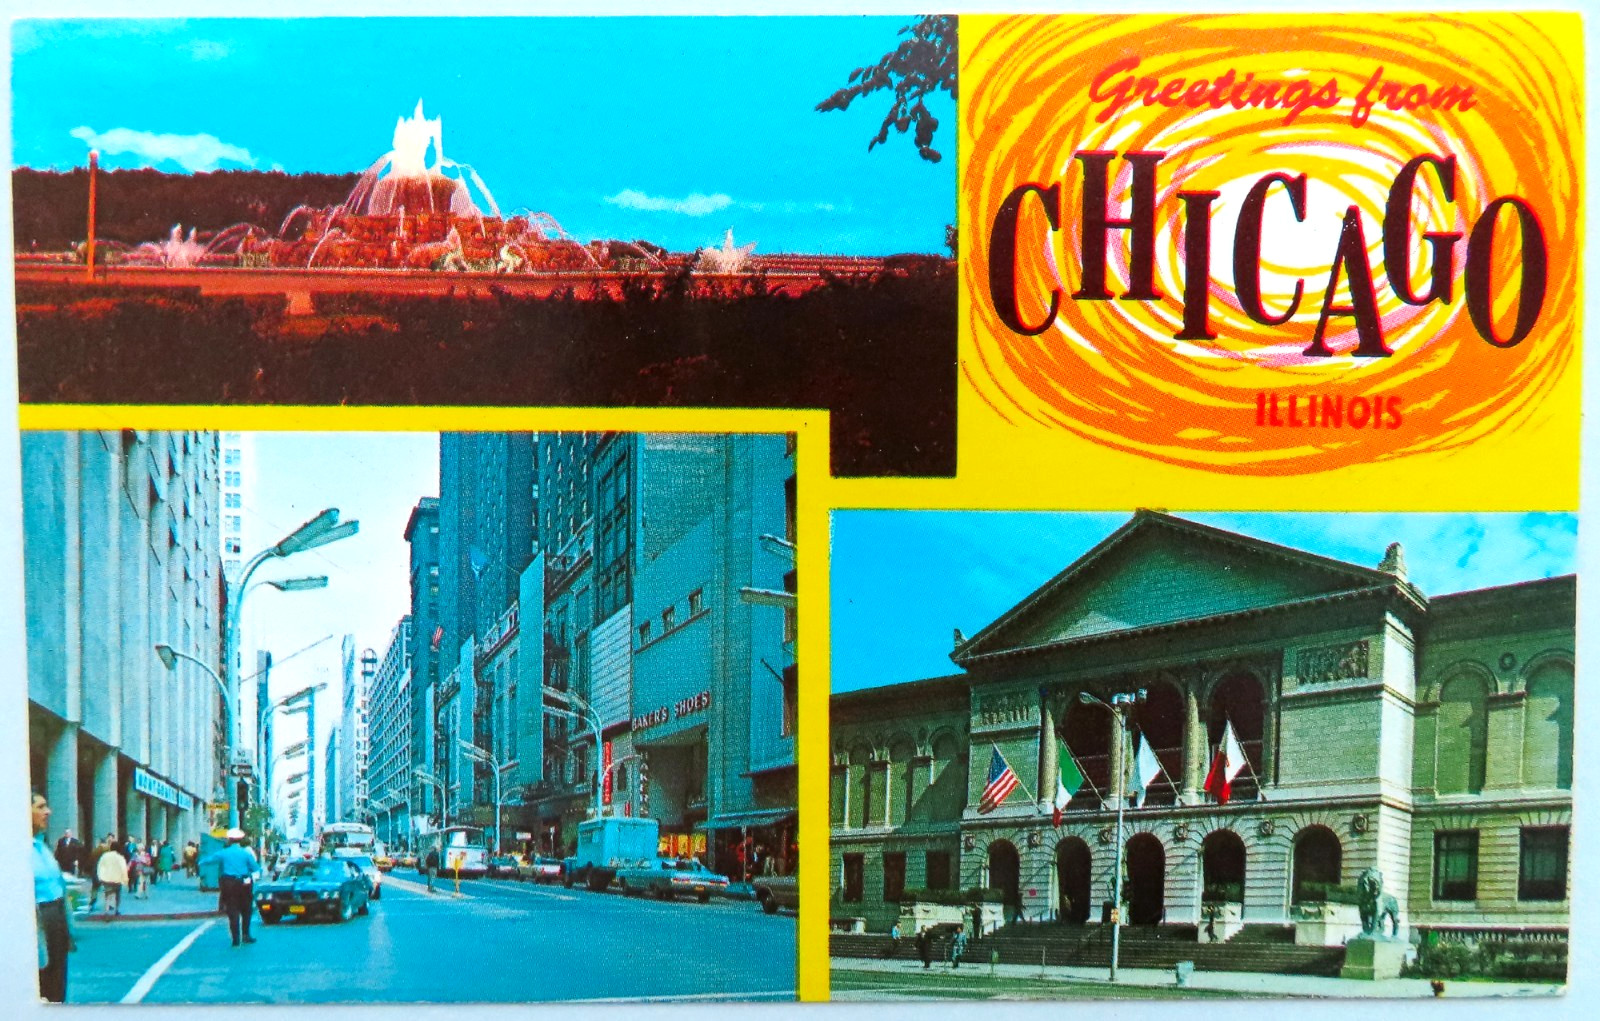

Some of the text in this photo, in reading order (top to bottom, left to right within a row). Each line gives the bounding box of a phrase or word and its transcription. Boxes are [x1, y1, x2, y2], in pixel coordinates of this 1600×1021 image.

[1089, 56, 1477, 128] Greetings from
[988, 149, 1548, 360] CHICAGO
[1255, 392, 1403, 431] ILLINOIS
[674, 691, 710, 719] SHOES
